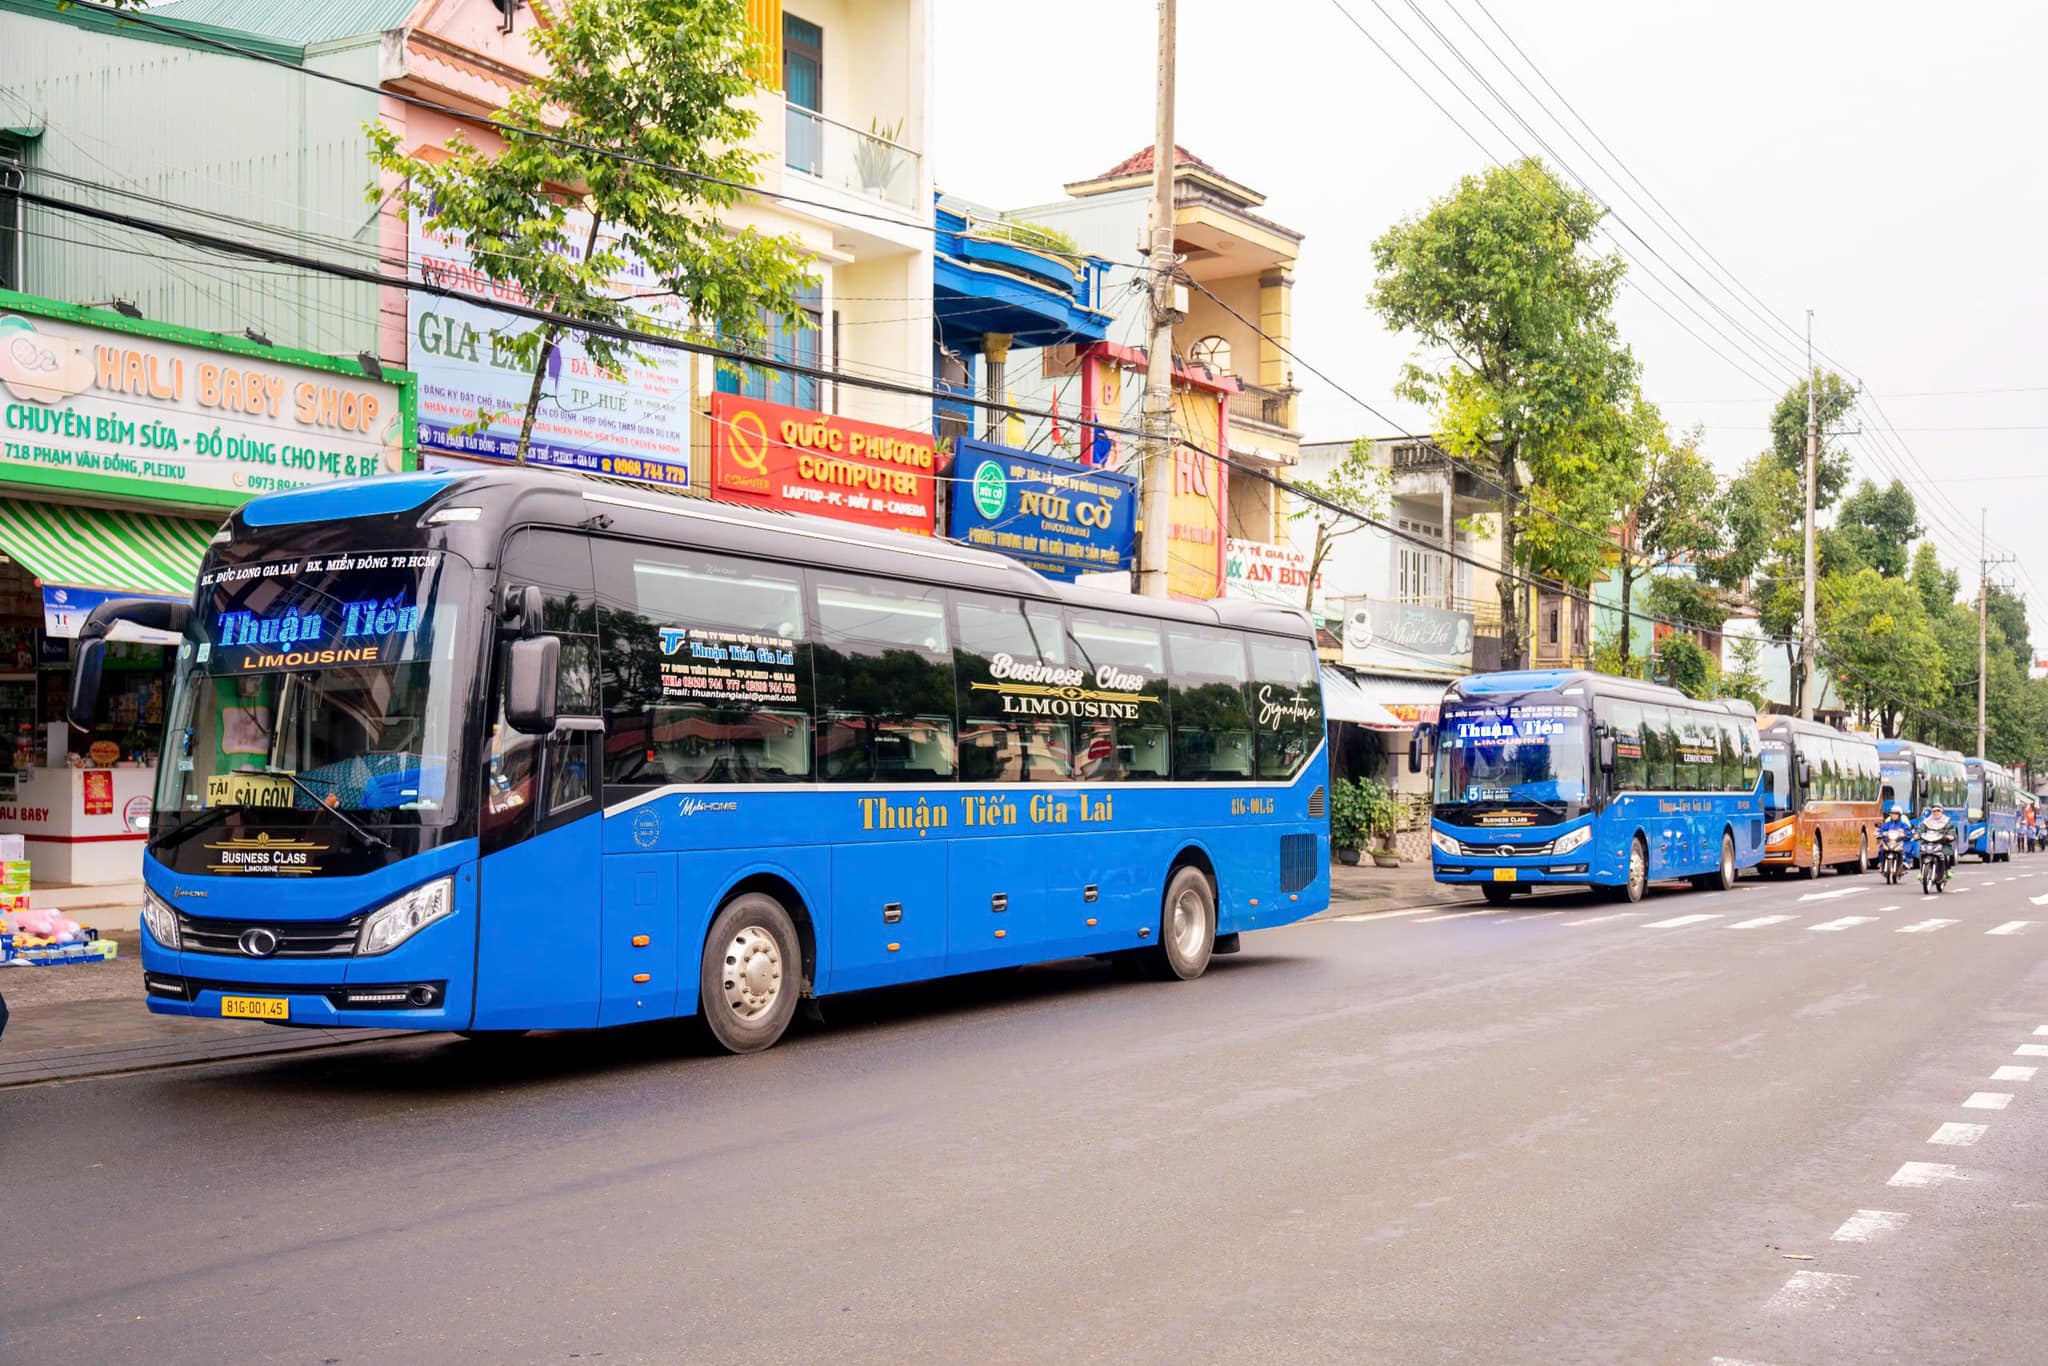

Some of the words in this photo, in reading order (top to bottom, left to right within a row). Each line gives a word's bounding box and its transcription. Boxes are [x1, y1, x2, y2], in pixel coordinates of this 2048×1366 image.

[418, 311, 480, 363] GIA
[95, 345, 184, 401] HALI
[198, 362, 286, 417] BABY
[294, 382, 380, 432] SHOP
[6, 404, 91, 439] CHUYÊN
[95, 412, 135, 445] BỈM
[140, 420, 179, 450] SỮA
[226, 434, 277, 465] DÙNG
[281, 445, 315, 470] CHO
[319, 450, 341, 478] MẸ
[344, 455, 357, 476] &
[360, 453, 380, 477] BÉ
[780, 416, 843, 452] QUỐC
[849, 432, 932, 468] PHƯƠNG
[4, 443, 30, 460] 718
[33, 446, 72, 467] PHẠM
[75, 451, 100, 470] VĂN
[143, 461, 186, 479] PLEIKU
[614, 457, 641, 476] 0968
[248, 475, 275, 491] 0973
[724, 474, 770, 489] COMPUTER
[798, 455, 917, 496] COMPUTER
[1265, 549, 1284, 560] GIA
[216, 567, 236, 583] ĐỨC
[236, 568, 261, 581] LONG
[262, 565, 283, 577] GIA
[283, 563, 299, 575] LAI
[305, 560, 324, 572] BX.
[326, 553, 353, 571] MIỀN
[356, 556, 388, 570] ĐÔNG
[407, 556, 437, 568] HCM
[1246, 563, 1273, 582] AN
[217, 604, 323, 652] Thuận
[342, 591, 421, 637] Tiến
[243, 647, 379, 669] LIMOUSINE
[690, 642, 728, 663] Thuận
[729, 644, 756, 662] Tiến
[757, 648, 775, 664] Gia
[776, 650, 794, 665] Lai
[989, 652, 1084, 687] Business
[1096, 665, 1145, 691] Class
[662, 687, 691, 697] Email:
[1002, 695, 1139, 719] LIMOUSINE
[1259, 685, 1316, 731] Signature
[1457, 721, 1514, 739] Thuận
[1523, 718, 1564, 735] Tiến
[1474, 737, 1546, 746] LIMOUSINE
[209, 778, 228, 796] TÀI
[235, 782, 257, 808] SÀI
[261, 781, 290, 808] GÒN
[1469, 786, 1478, 801] 5
[21, 808, 49, 822] BABY
[858, 796, 948, 838] Thuận
[961, 794, 1017, 827] Tiến
[1030, 793, 1068, 824] Gia
[1079, 793, 1113, 822] Lai
[222, 851, 269, 864] BUSINESS
[273, 851, 307, 864] CLASS
[226, 1000, 283, 1015] 81G-001.45
